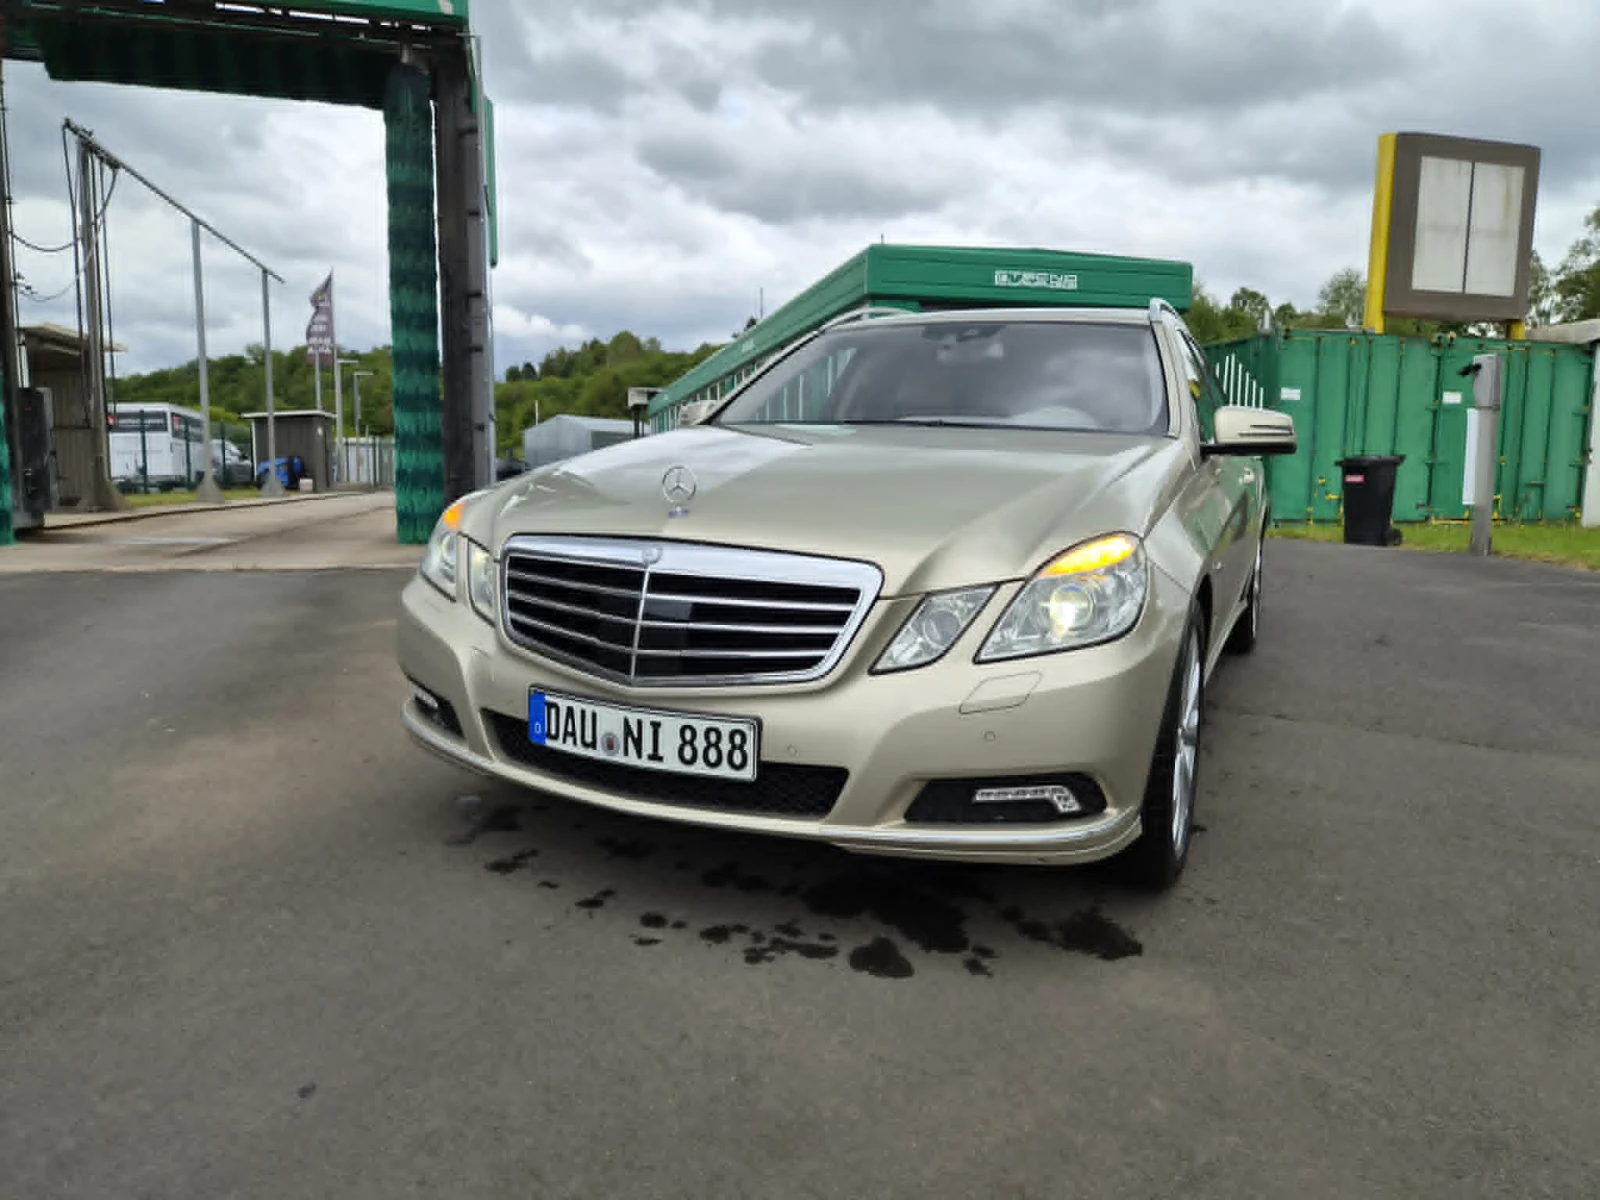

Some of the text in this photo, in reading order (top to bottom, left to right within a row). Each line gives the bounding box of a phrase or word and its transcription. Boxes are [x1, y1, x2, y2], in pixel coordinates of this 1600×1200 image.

[545, 702, 748, 771] DAU NI 888
